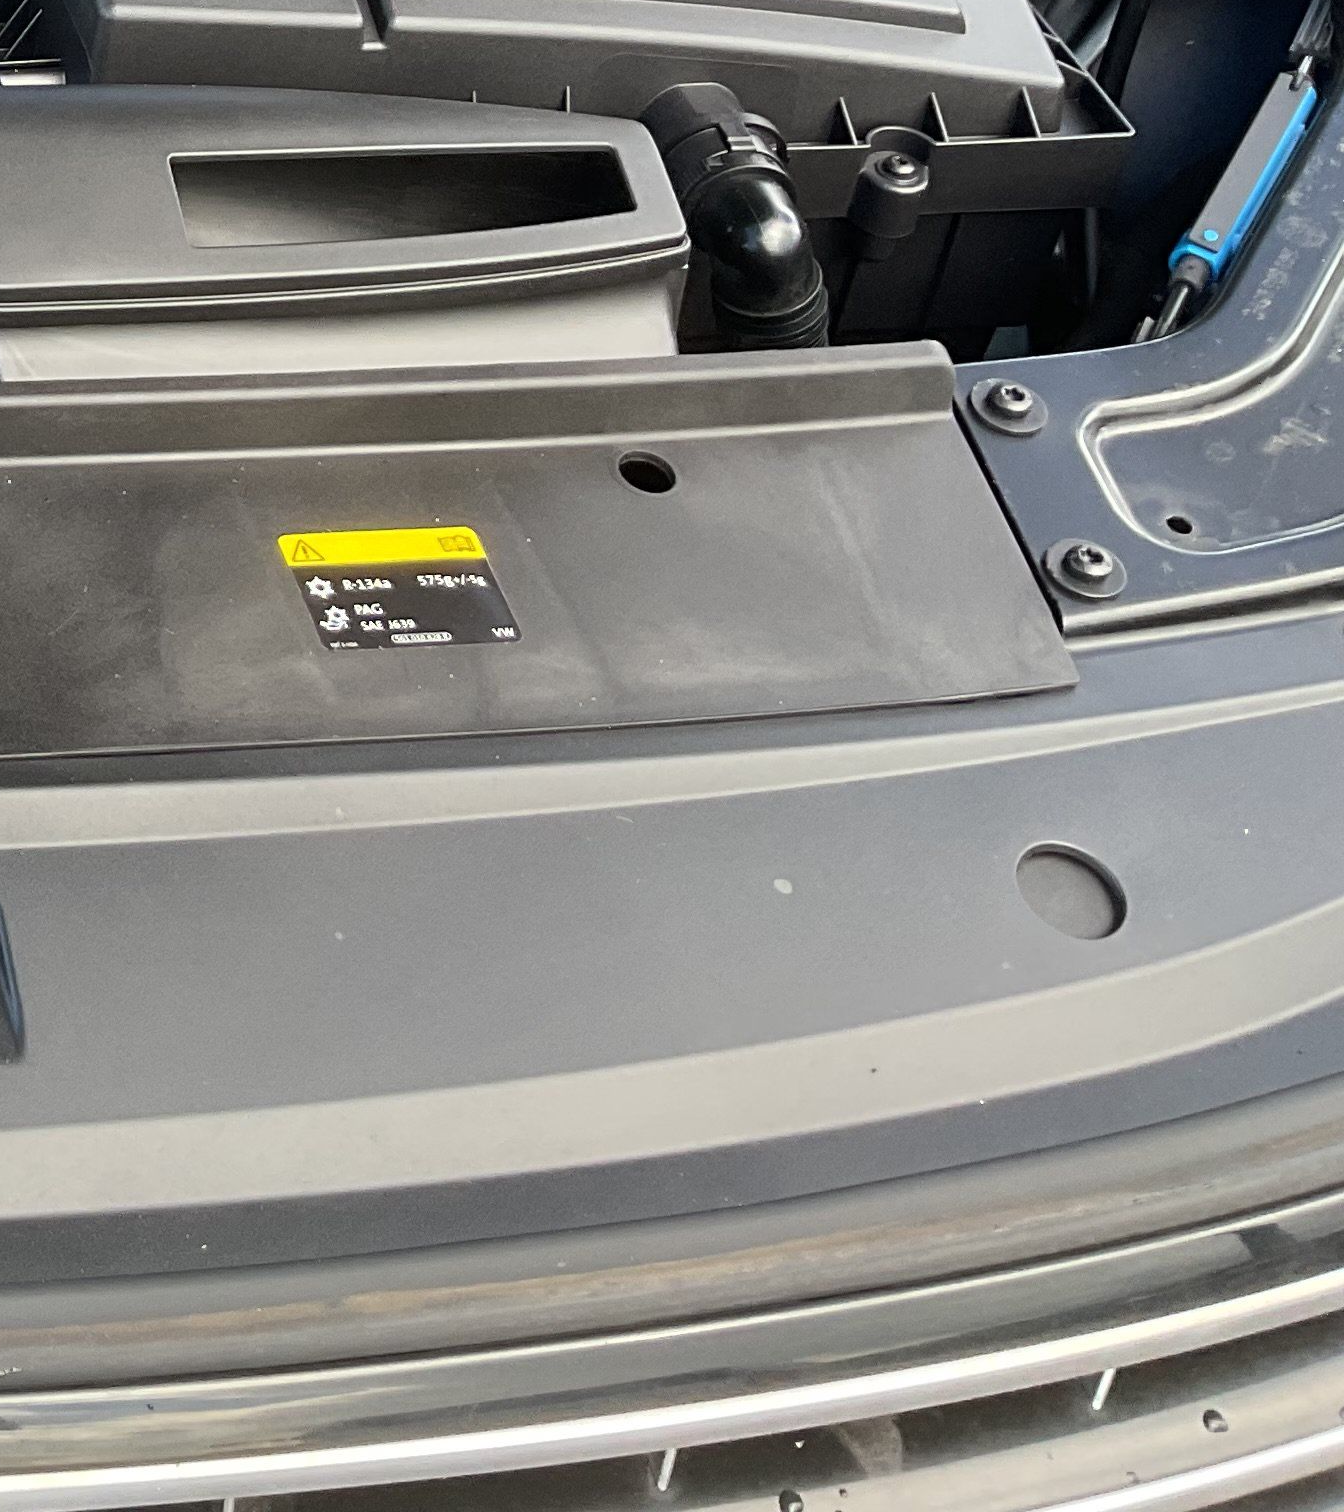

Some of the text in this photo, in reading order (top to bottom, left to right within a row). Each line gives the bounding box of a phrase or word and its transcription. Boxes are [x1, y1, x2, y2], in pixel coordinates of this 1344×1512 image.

[354, 602, 384, 616] PAG
[360, 619, 385, 631] SAE
[491, 627, 515, 638] VW
